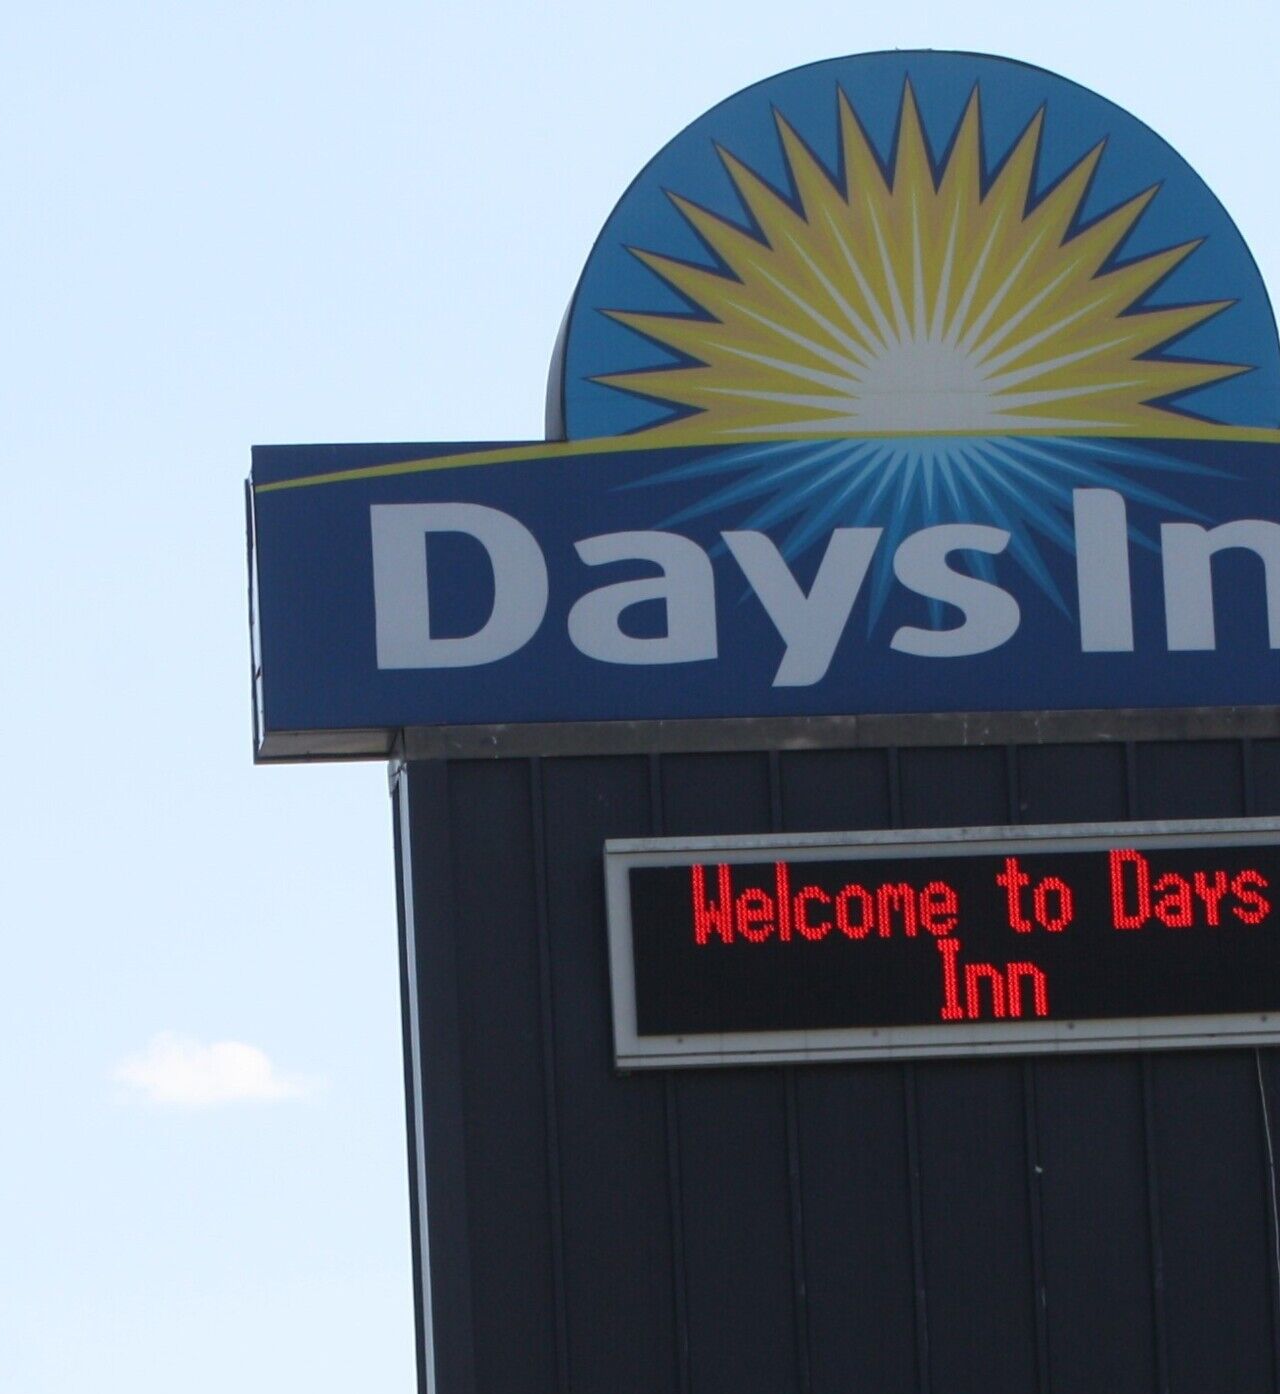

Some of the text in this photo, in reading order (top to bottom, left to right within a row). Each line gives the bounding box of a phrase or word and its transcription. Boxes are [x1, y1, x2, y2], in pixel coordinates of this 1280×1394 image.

[369, 502, 1021, 687] Days
[692, 848, 1270, 944] Welcome to Days
[937, 937, 1049, 1020] Inn
